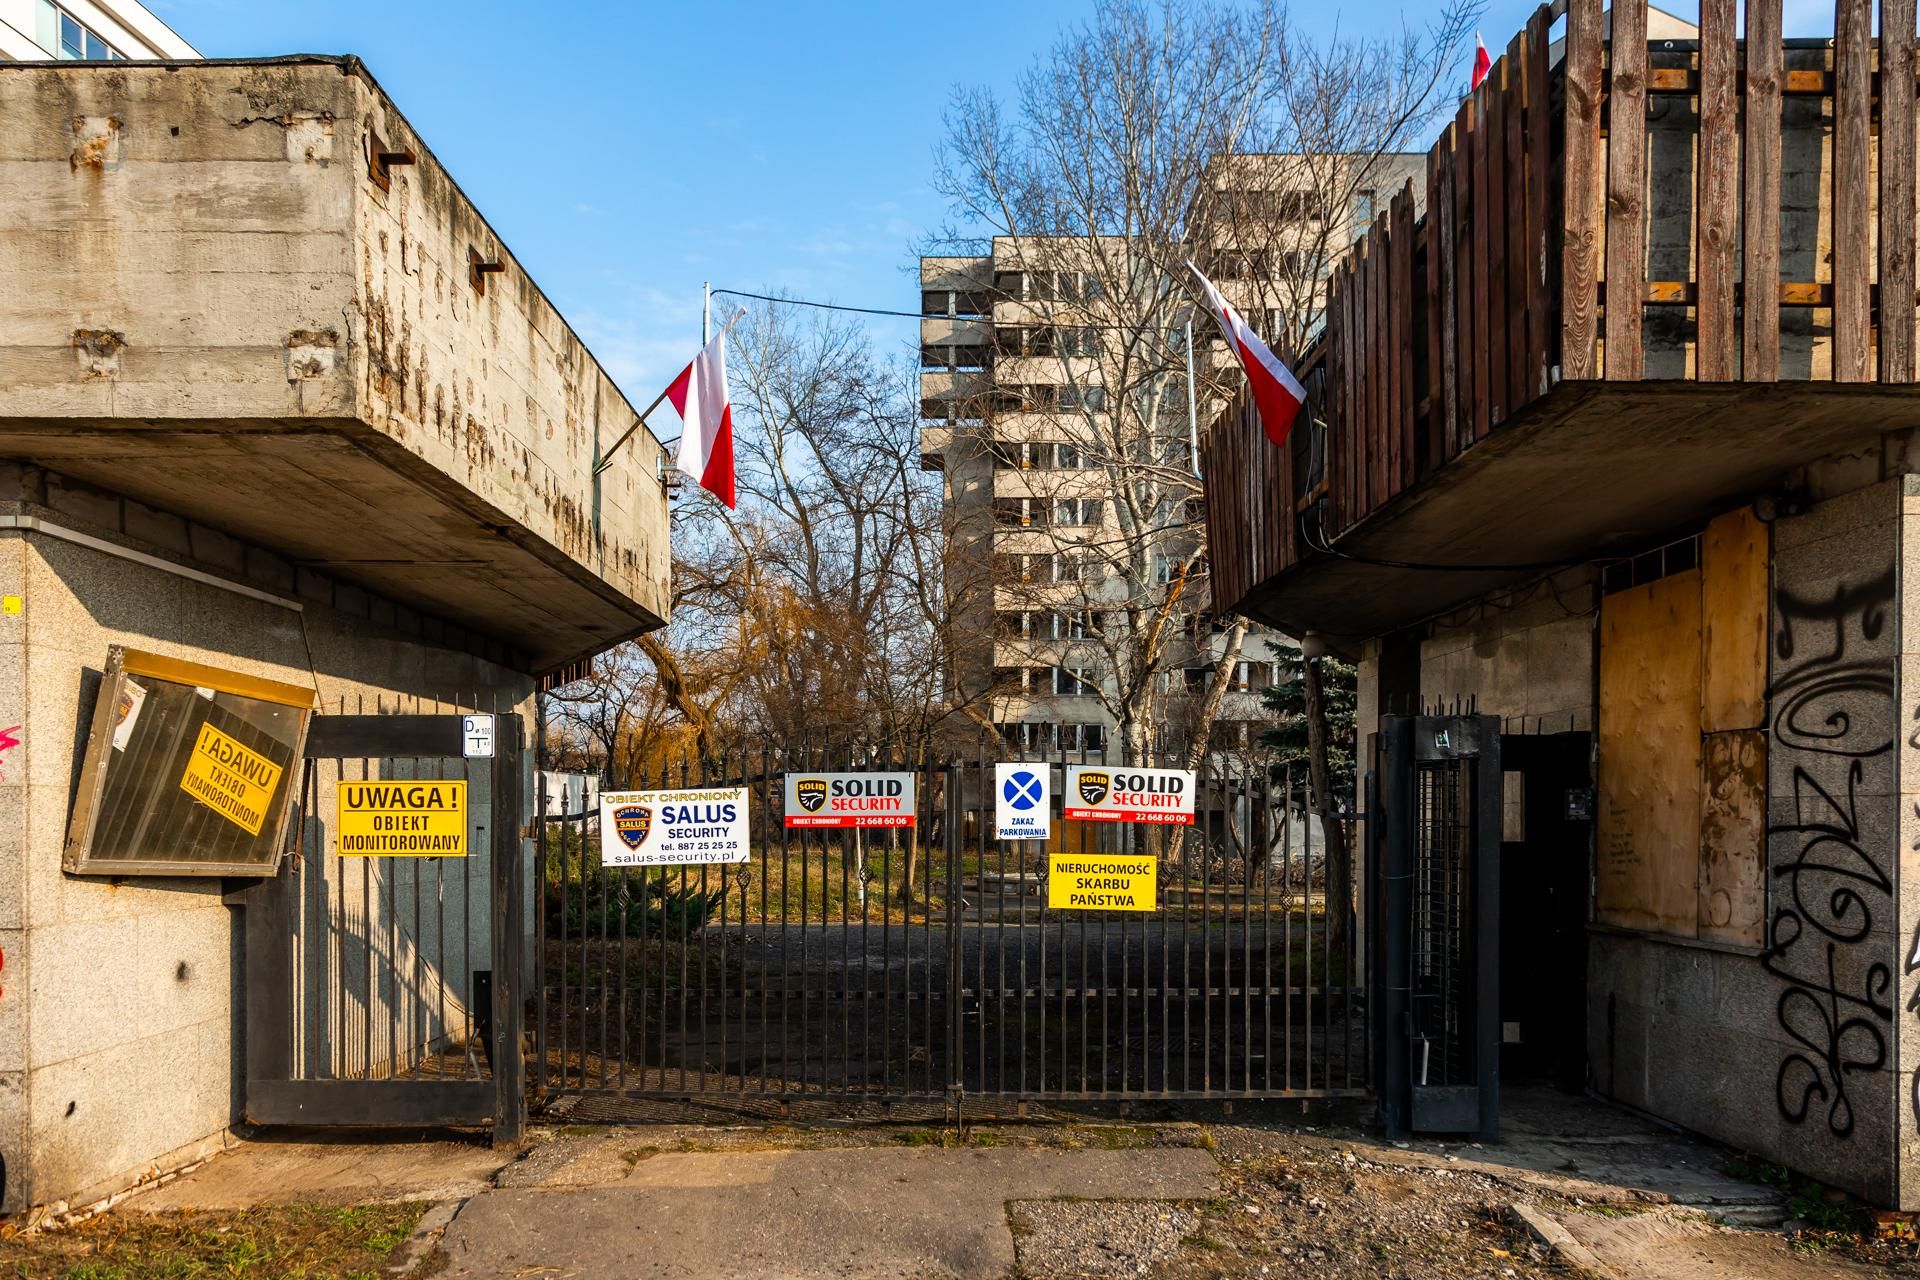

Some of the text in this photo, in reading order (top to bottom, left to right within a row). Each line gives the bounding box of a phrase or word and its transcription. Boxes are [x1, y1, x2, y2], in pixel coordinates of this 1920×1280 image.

[465, 720, 474, 732] D
[1080, 775, 1108, 785] SOLID
[1113, 774, 1184, 794] SOLID
[799, 783, 825, 791] SOLID
[831, 779, 903, 797] SOLID
[605, 791, 742, 804] OBIEKT CHRONIONY
[1112, 792, 1184, 808] SECURITY
[831, 798, 902, 811] SECURITY
[616, 807, 649, 818] OCHRONA
[661, 804, 737, 825] SALUS
[1135, 813, 1187, 822] 22 668 60 06
[373, 816, 430, 831] OBIEKT
[619, 820, 646, 828] SALUS
[855, 817, 907, 825] 22 668 60 06
[1011, 818, 1034, 826] ZAKAZ
[620, 831, 646, 845] SECURITY
[668, 827, 730, 839] SECURITY
[999, 828, 1047, 837] PARKOWANIA
[343, 835, 460, 850] MONITOROWANY
[661, 841, 738, 851] tel. 887 25 25 25
[614, 851, 734, 863] salus-security.pl
[1056, 862, 1150, 875] NIERUCHOMOŚĆ
[1076, 878, 1130, 890] SKARBU
[1070, 891, 1135, 906] PAŃSTWA
